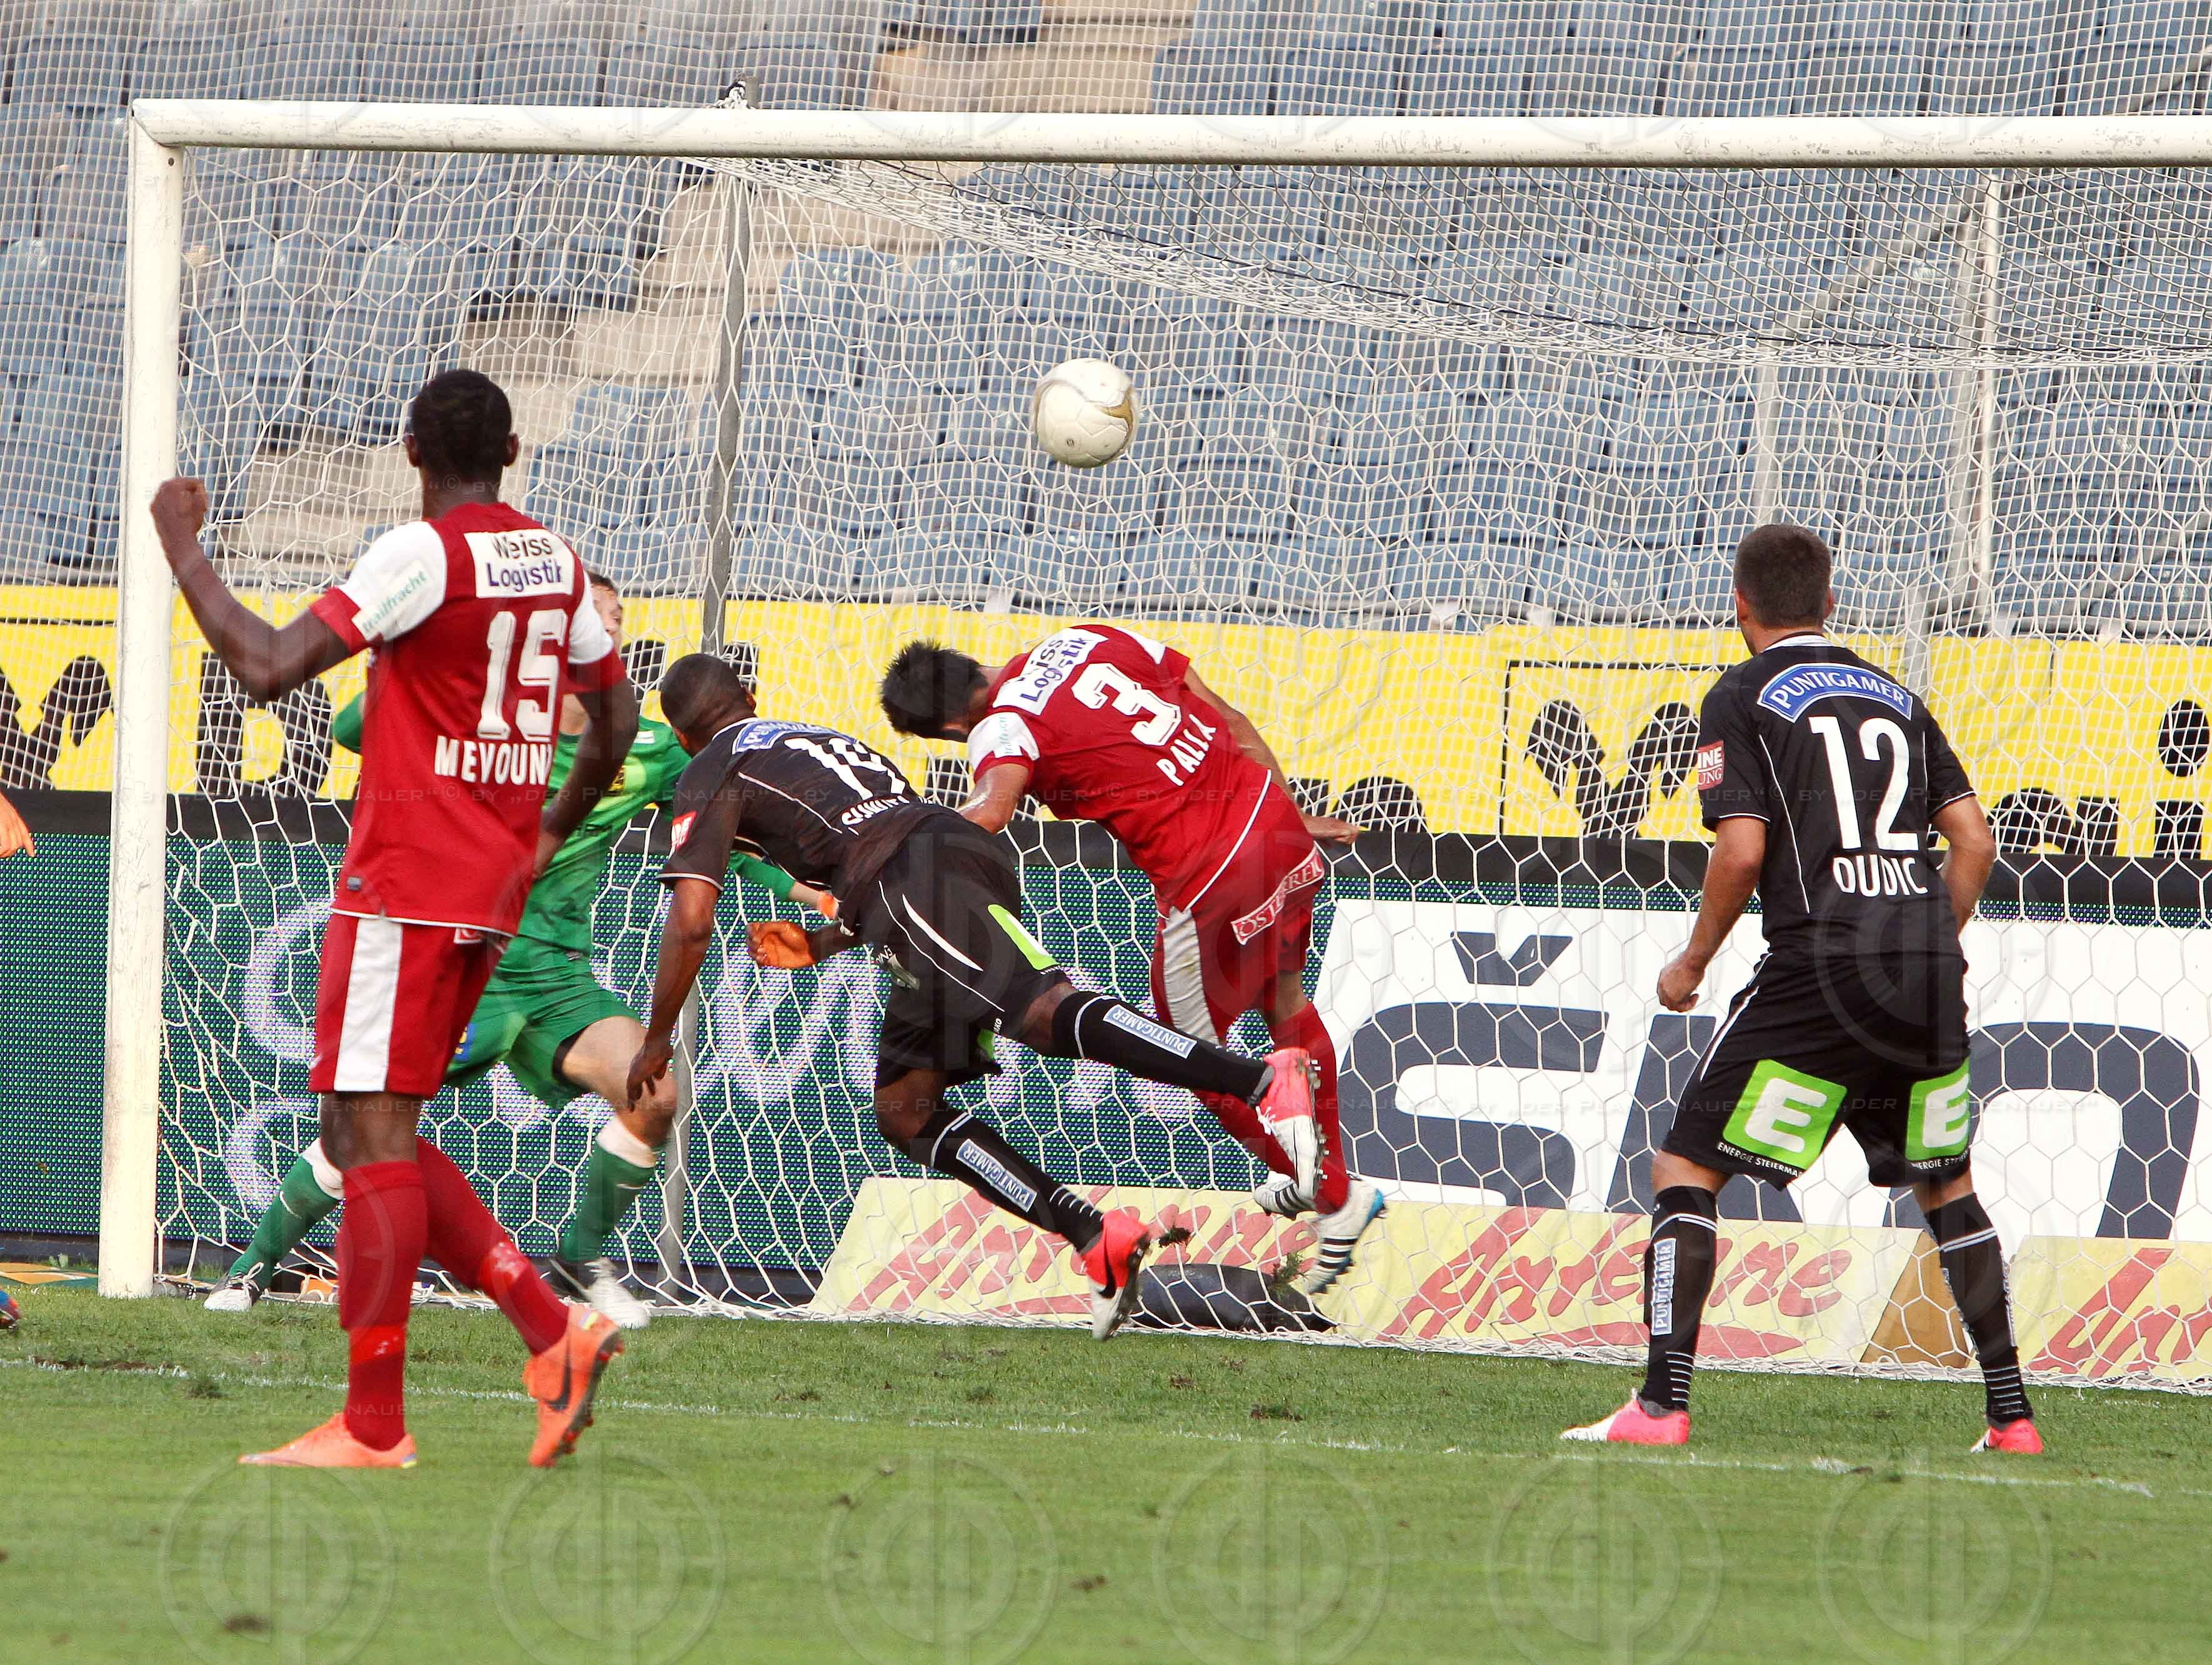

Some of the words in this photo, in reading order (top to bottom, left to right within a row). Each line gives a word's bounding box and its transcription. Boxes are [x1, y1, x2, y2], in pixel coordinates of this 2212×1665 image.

[491, 533, 553, 560] Weiss
[477, 608, 568, 743] 15
[1070, 662, 1182, 746] 3
[1770, 671, 1905, 709] PUNTIGAMER
[434, 734, 554, 786] MEVOUN
[1155, 713, 1217, 787] PALLA
[1808, 716, 1920, 851] 12
[1832, 854, 1928, 897] DUDIC
[1112, 1007, 1192, 1053] PUNTIGAMER
[1745, 1078, 1828, 1154] E
[1923, 1073, 1969, 1149] E
[962, 1144, 1032, 1211] PUNTIGAMER
[1716, 1141, 1754, 1164] ENERGIE
[1755, 1156, 1802, 1178] STEIERMA
[1654, 1241, 1673, 1331] PUNTIGAMER
